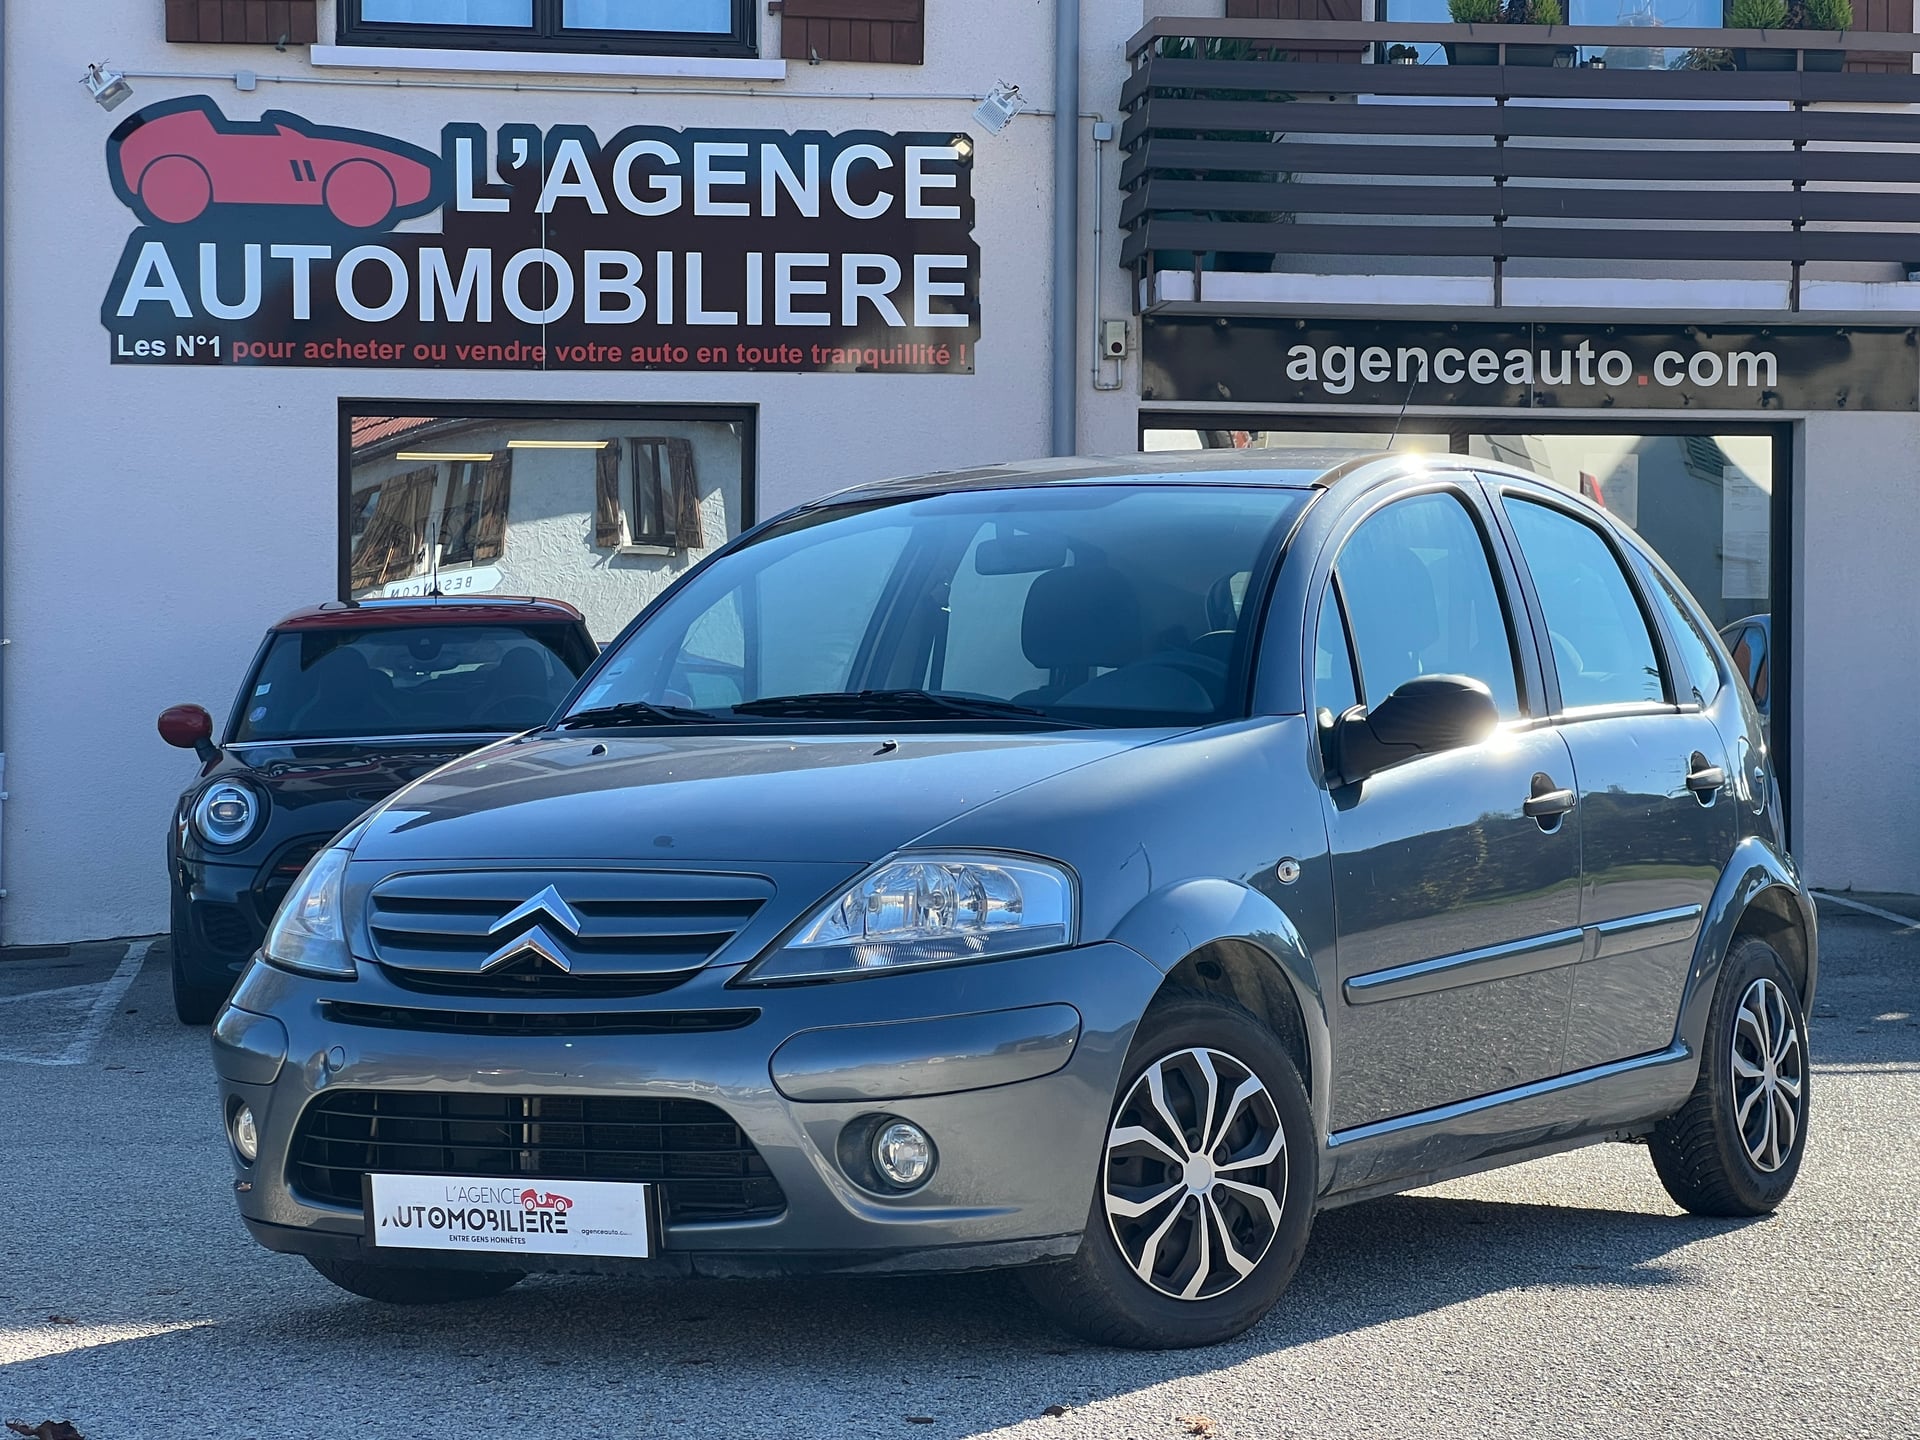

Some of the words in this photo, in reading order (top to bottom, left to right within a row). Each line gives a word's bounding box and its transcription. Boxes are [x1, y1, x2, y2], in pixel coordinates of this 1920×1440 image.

[455, 137, 961, 220] L'AGENCE
[116, 241, 970, 328] AUTOMOBILIERE
[117, 334, 167, 357] Les
[175, 335, 221, 358] N°1
[232, 340, 296, 363] pour
[303, 338, 405, 361] acheter
[413, 345, 448, 362] ou
[455, 339, 546, 363] vendre
[556, 342, 622, 364] votre
[630, 342, 689, 364] auto
[697, 346, 728, 364] en
[736, 342, 803, 364] toute
[811, 342, 950, 368] tranquillité
[1286, 339, 1778, 395] agenceauto.com
[445, 1186, 522, 1205] L'AGENCE
[449, 1234, 470, 1243] ENTRE
[471, 1235, 489, 1243] GENS
